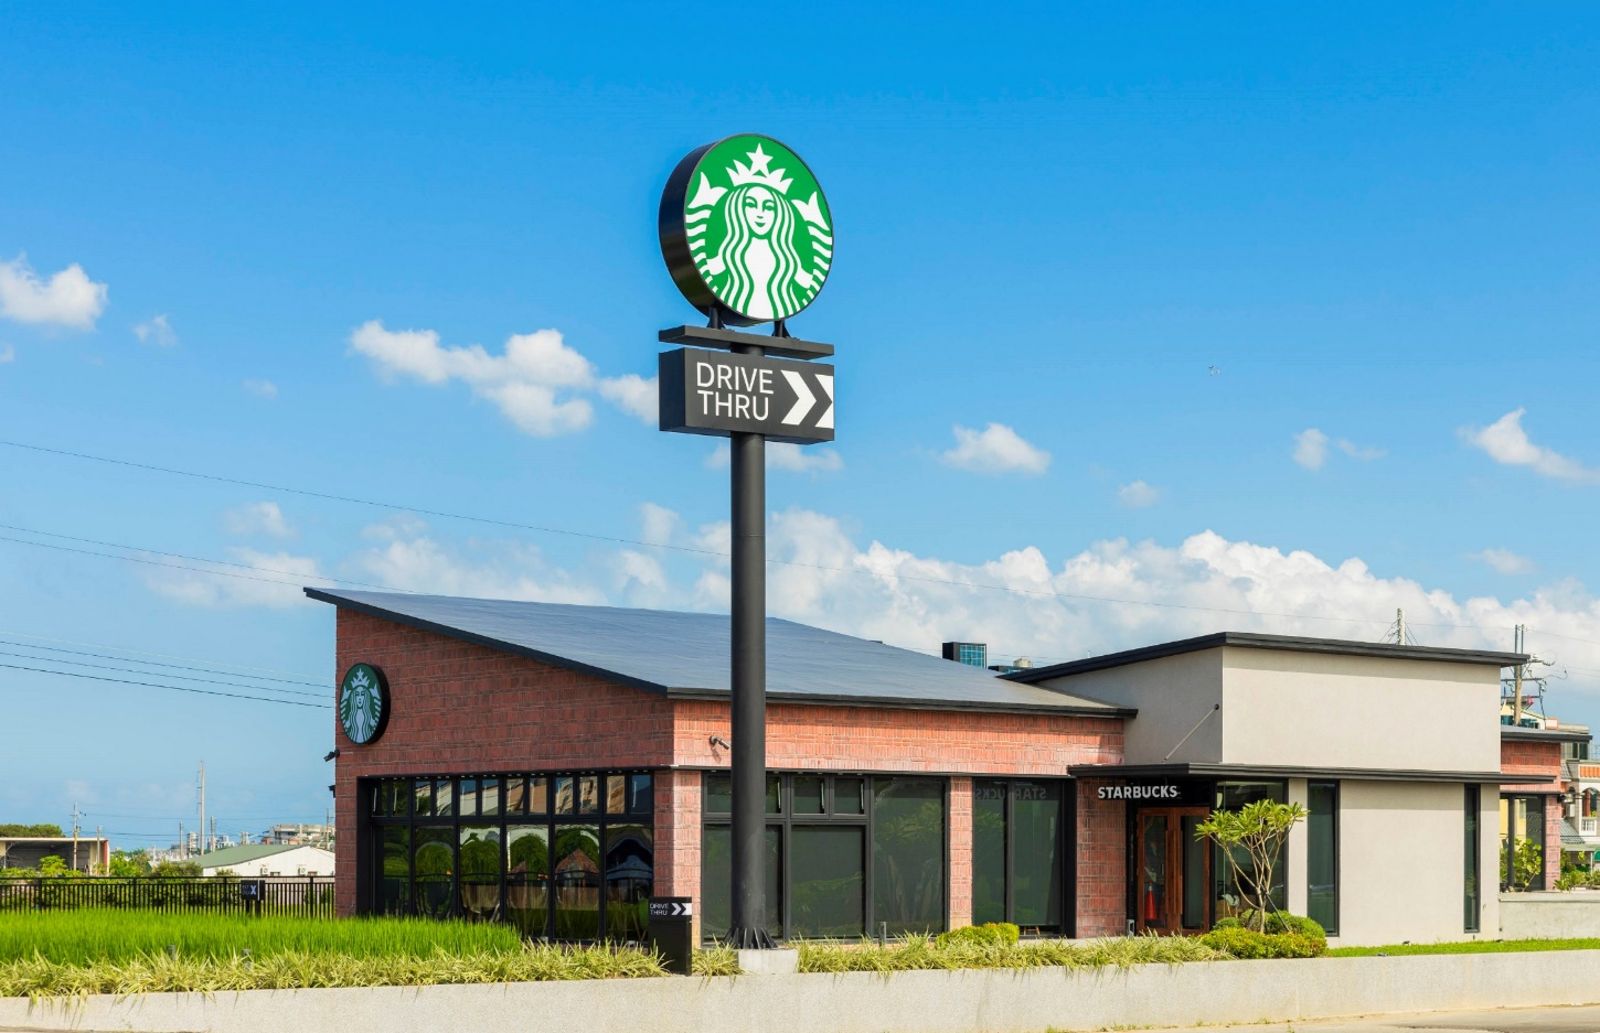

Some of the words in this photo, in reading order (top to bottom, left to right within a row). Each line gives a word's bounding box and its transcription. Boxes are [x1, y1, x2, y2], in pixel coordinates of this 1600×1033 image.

[696, 362, 774, 394] DRIVE
[697, 390, 769, 421] THRU
[1097, 785, 1178, 799] STARBUCKS
